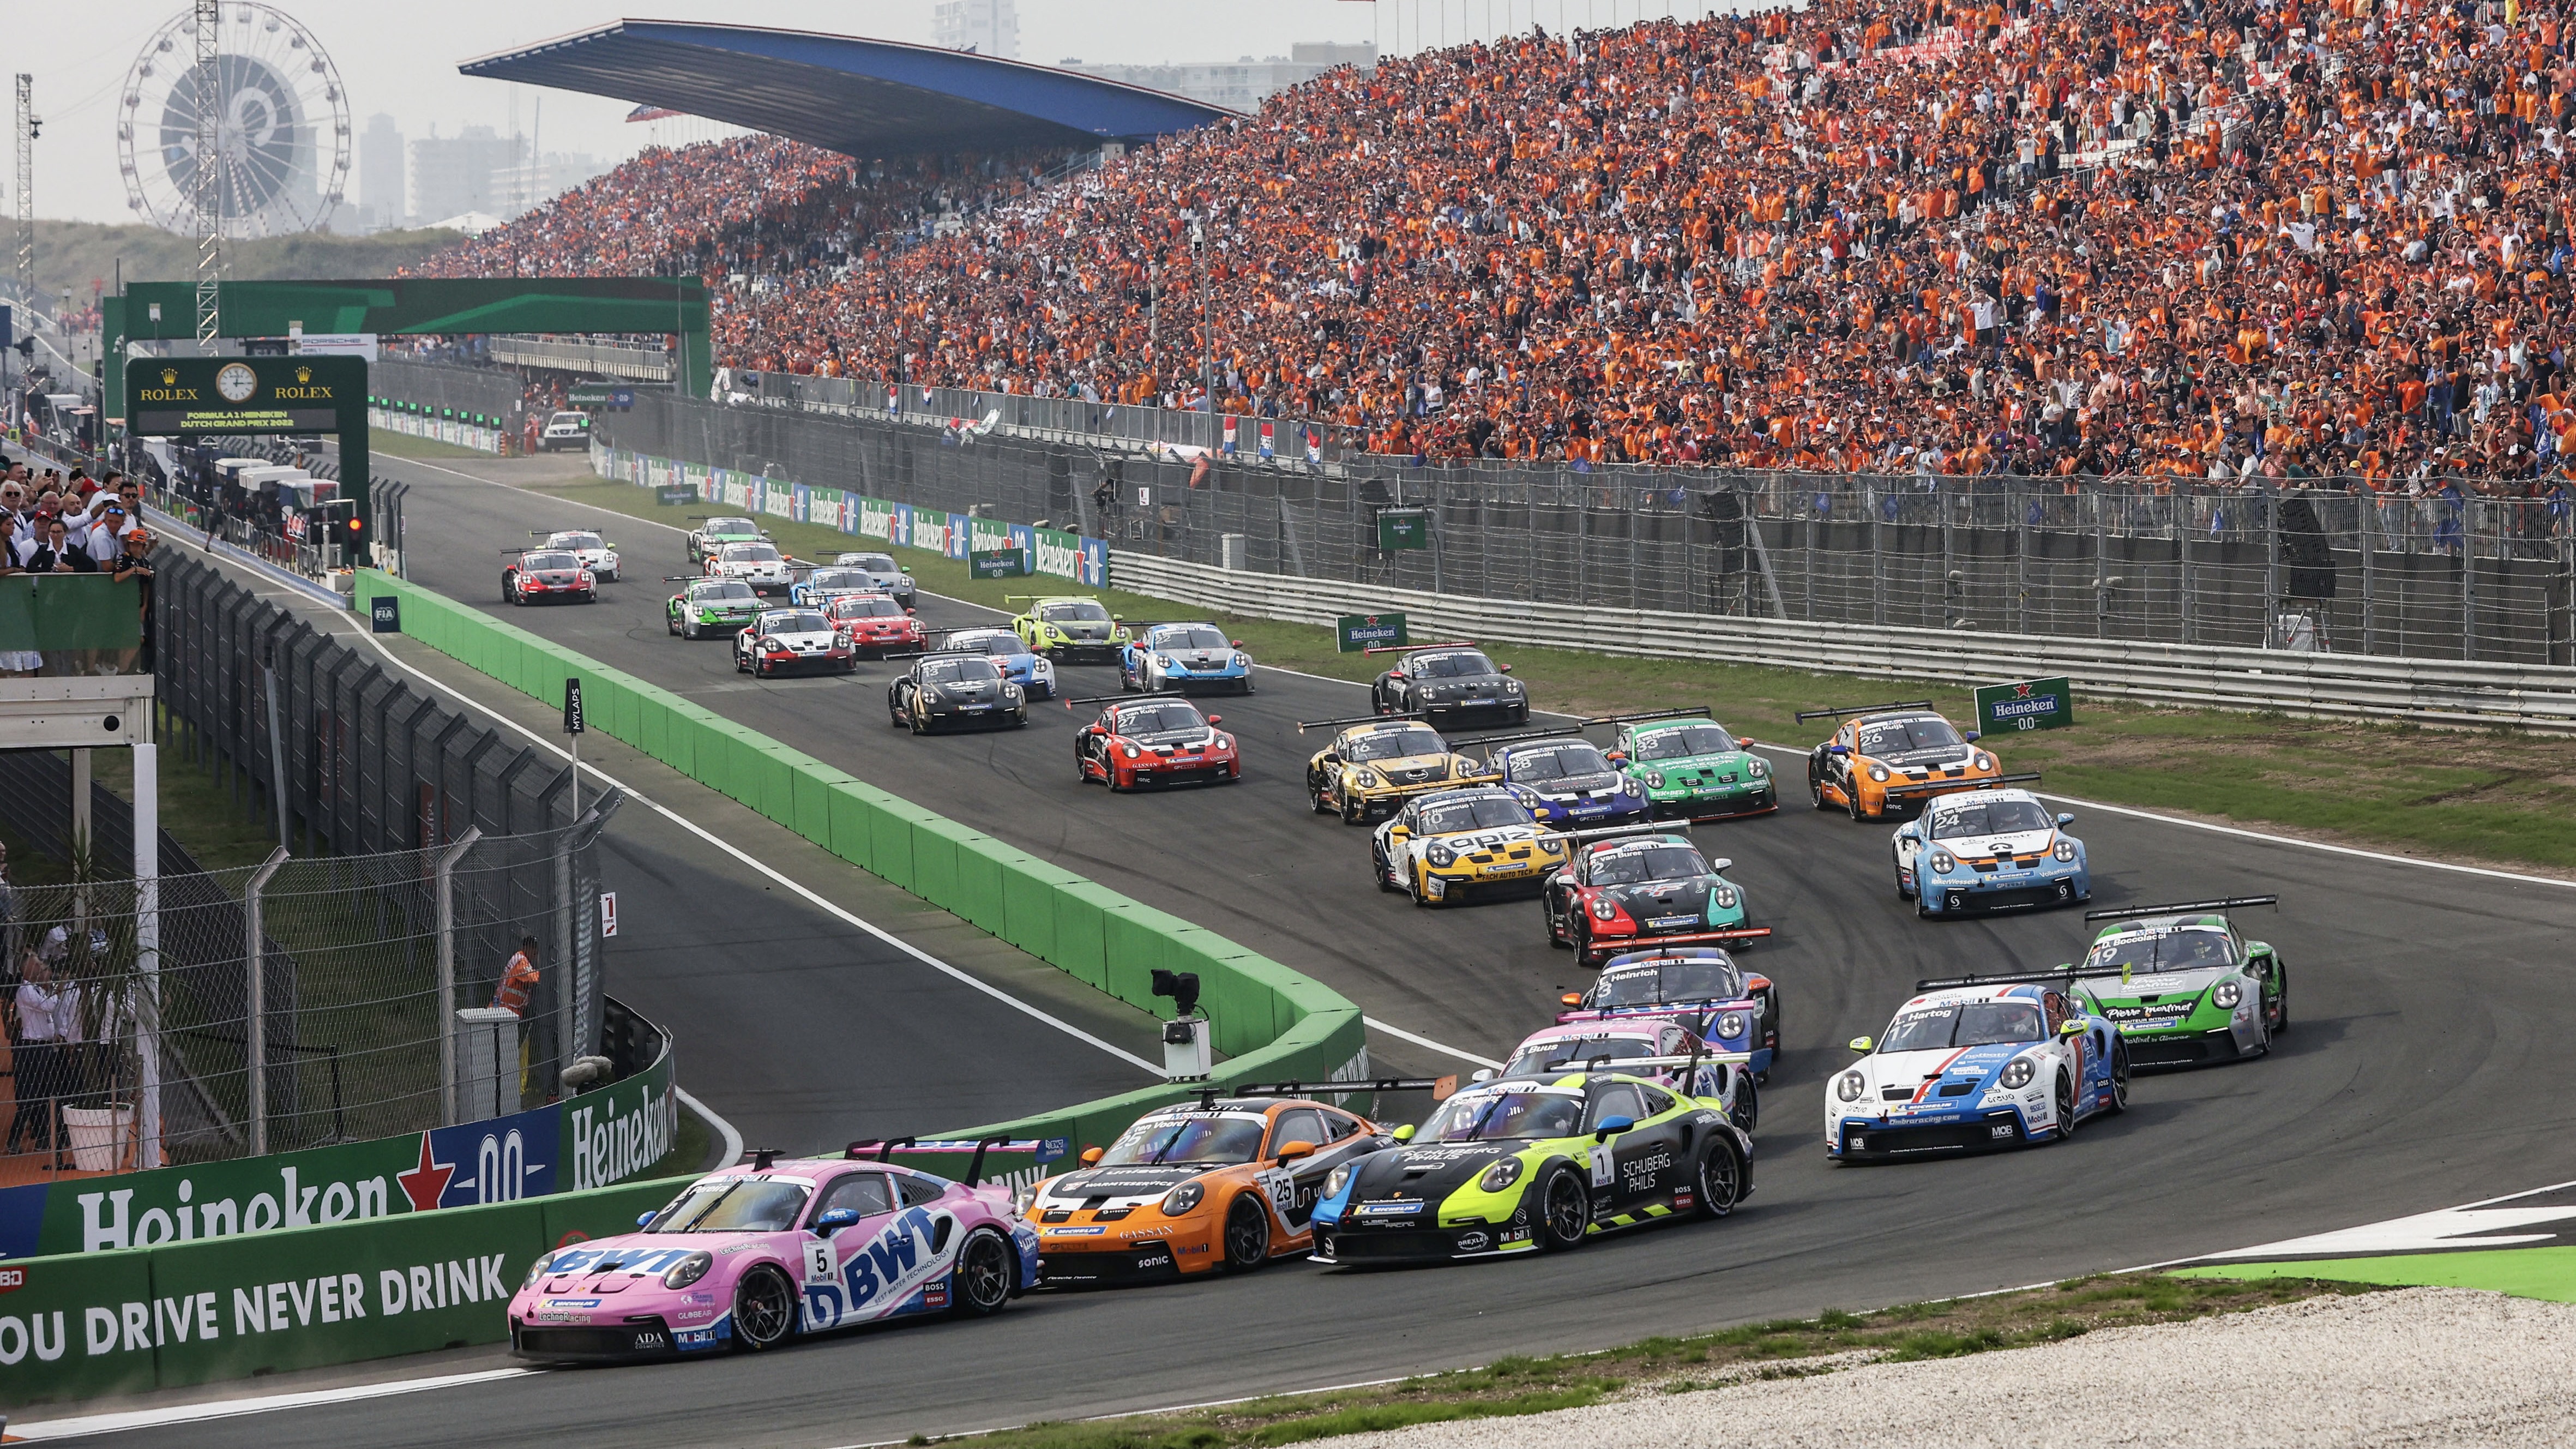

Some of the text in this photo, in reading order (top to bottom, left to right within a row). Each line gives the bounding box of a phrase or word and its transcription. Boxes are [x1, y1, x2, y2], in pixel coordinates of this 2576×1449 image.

[141, 389, 198, 401] ROLEX
[275, 387, 333, 399] ROLEX
[860, 500, 888, 539] Heineken
[913, 511, 944, 551] Heineken
[1035, 533, 1075, 578] Heineken
[980, 560, 1015, 568] Heineken
[376, 609, 395, 618] FIA
[839, 605, 853, 614] 14
[764, 620, 780, 629] 30
[1351, 628, 1395, 639] Heineken
[1155, 635, 1171, 645] 22
[924, 669, 939, 678] 13
[947, 680, 986, 689] OK
[1437, 682, 1501, 690] CETREZ
[573, 688, 581, 730] MYLAPS
[1995, 700, 2055, 717] Heineken
[1118, 716, 1136, 729] 27
[2018, 717, 2035, 730] 0.0
[1636, 739, 1659, 753] 33
[1859, 734, 1883, 747] 26
[1351, 743, 1370, 755] 16
[1899, 747, 1961, 756] uniserver
[1515, 751, 1555, 762] Groeneveld
[1695, 754, 1739, 763] DENTAL
[1905, 752, 1963, 761] WARMTESERVICE
[1509, 759, 1532, 772] 28
[1550, 772, 1611, 783] uniserver
[1966, 798, 1994, 806] Mobil
[1954, 804, 1987, 814] Splunterer
[1422, 813, 1443, 827] 10
[1935, 815, 1960, 830] 24
[1449, 831, 1533, 849] apiz
[1617, 850, 1643, 858] Buren
[1622, 844, 1650, 852] Mobil
[1482, 869, 1533, 881] FACH AUTO TECH
[1592, 862, 1605, 876] 2
[1931, 875, 1978, 886] VolkerWessels
[2135, 927, 2169, 935] Mobil
[2101, 933, 2166, 949] D. Boccolacci
[2091, 947, 2117, 966] 19
[1640, 959, 1672, 968] Mobil
[1611, 969, 1658, 983] Heinrich
[1598, 983, 1612, 999] 3
[1939, 998, 1975, 1007] Mobil
[1895, 1010, 1952, 1025] L. Hartog
[2106, 1007, 2141, 1019] Pierre
[2065, 1019, 2081, 1029] PIN
[1560, 1033, 1595, 1042] Mobil
[1889, 1021, 1918, 1042] 17
[1516, 1043, 1559, 1057] B. Buus
[2097, 1079, 2109, 1087] BOSS
[1485, 1087, 1525, 1095] Mobil
[1889, 1114, 1960, 1125] Ombraracing.com
[2027, 1113, 2043, 1125] Mobil
[1134, 1122, 1152, 1133] ten
[1992, 1125, 2013, 1137] MOB
[1850, 1138, 1864, 1148] MOB
[1401, 1147, 1502, 1157] SCHUBERG
[1404, 1153, 1462, 1162] PHILIS
[77, 1167, 387, 1252] Heineken
[571, 1084, 668, 1191] Heineken
[1597, 1152, 1605, 1175] 1
[1623, 1152, 1671, 1179] SCHUBERG
[690, 1183, 730, 1195] Pereira
[1628, 1173, 1656, 1193] PHILIS
[1275, 1179, 1292, 1203] 25
[1276, 1201, 1287, 1210] Mobil
[1120, 1225, 1174, 1240] GASSAN
[1500, 1231, 1524, 1242] Mobil
[1458, 1234, 1489, 1247] DREXLER
[1177, 1246, 1201, 1255] Mobil
[546, 1249, 697, 1272] BWT
[815, 1249, 826, 1273] 5
[844, 1206, 938, 1311] BWT
[811, 1273, 826, 1282] Mobil
[874, 1248, 950, 1306] BEST WATER TECHNOLOGY
[925, 1283, 945, 1291] BOSS
[86, 1291, 219, 1356] DRIVE
[233, 1274, 366, 1336] NEVER
[380, 1253, 509, 1315] DRINK
[678, 1309, 713, 1320] GLOBEAIR
[635, 1332, 664, 1344] ADA
[678, 1330, 706, 1344] Mobil
